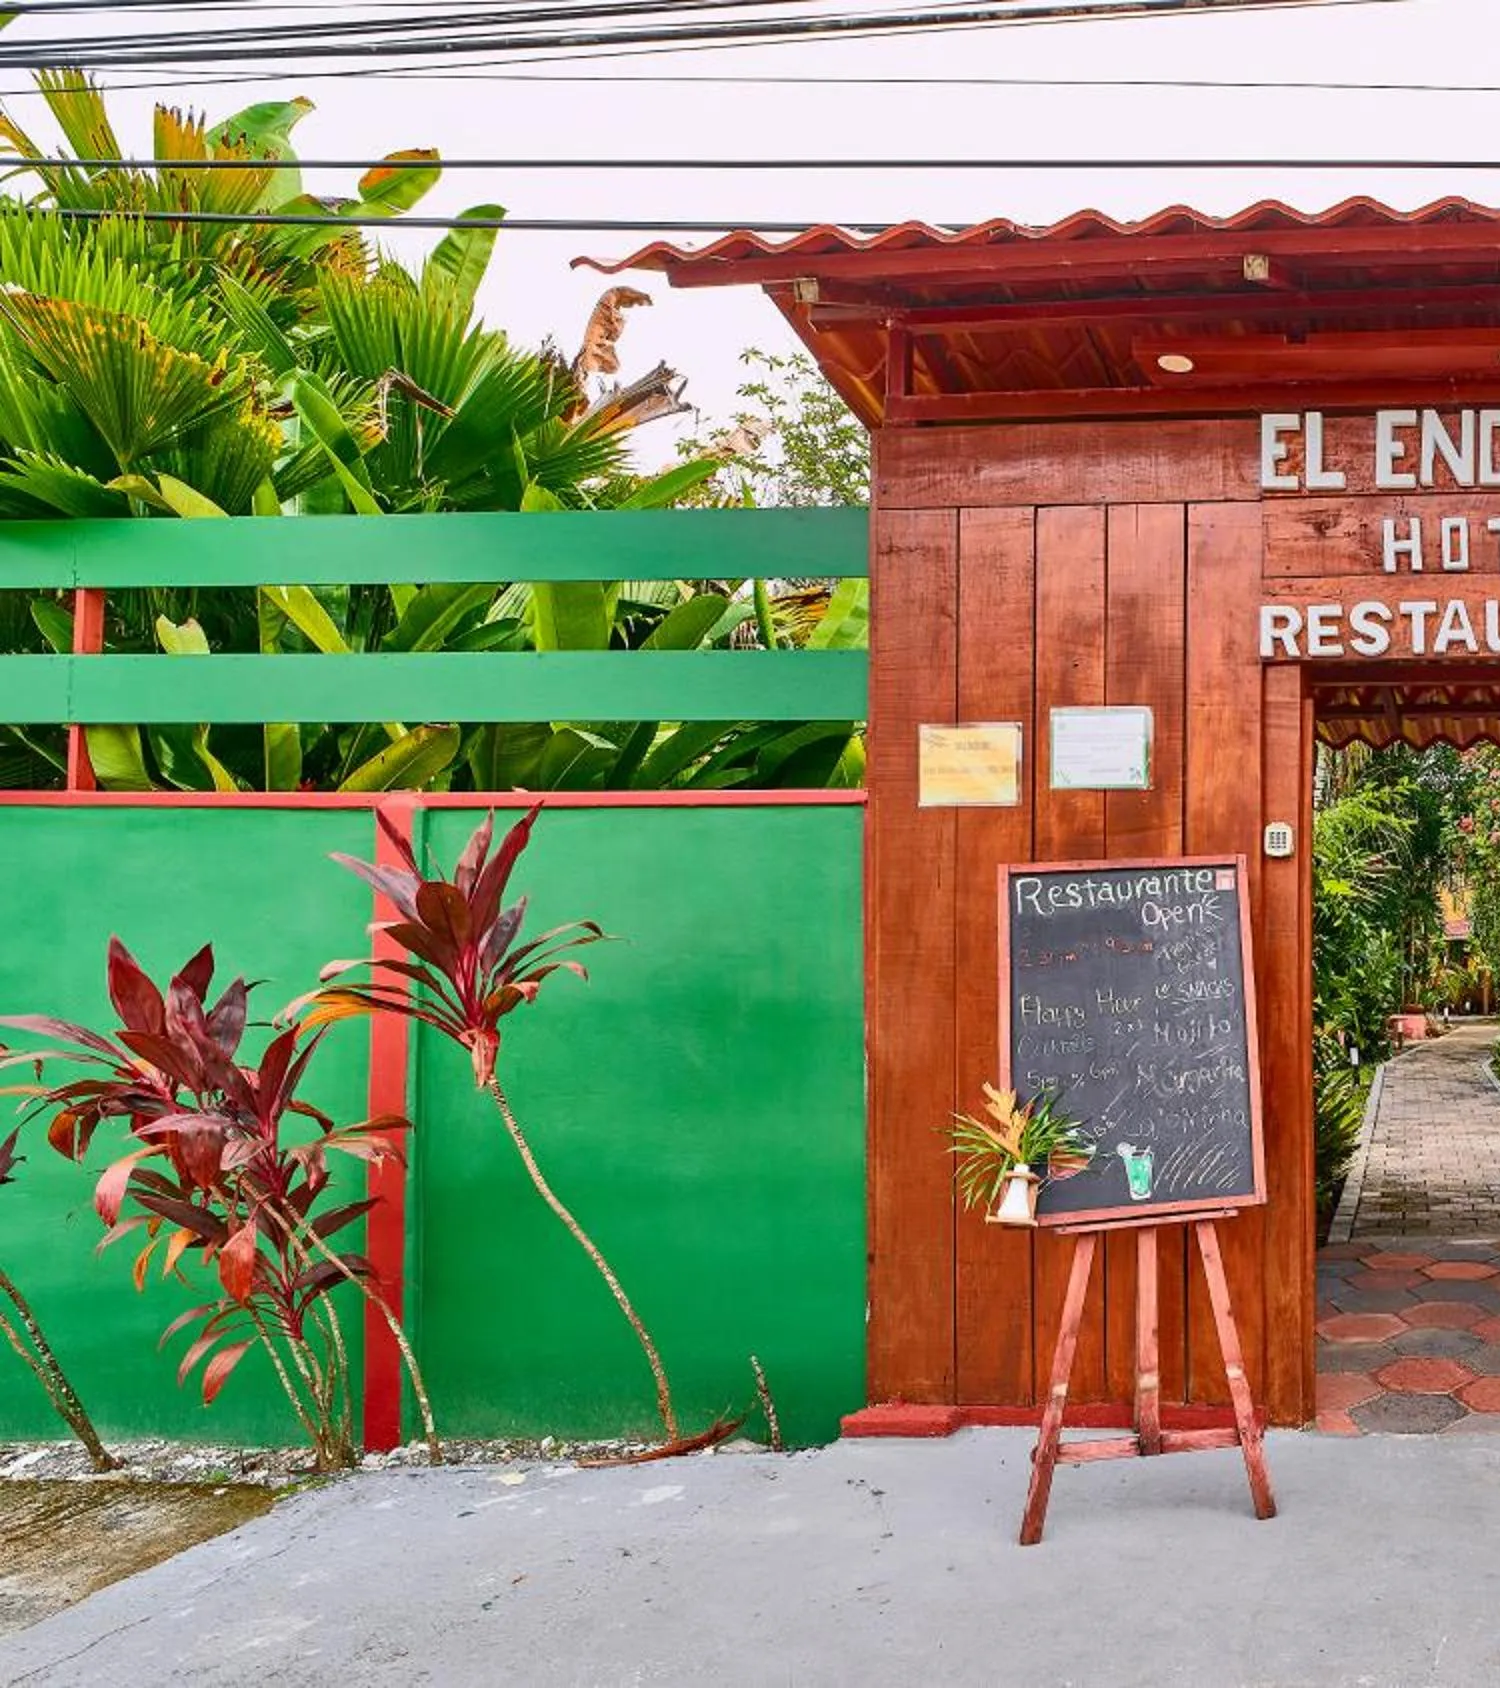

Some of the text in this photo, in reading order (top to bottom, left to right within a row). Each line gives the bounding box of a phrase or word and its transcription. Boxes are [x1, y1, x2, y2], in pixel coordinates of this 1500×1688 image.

[1261, 410, 1347, 491] EL
[1016, 869, 1212, 916] Restaurante
[1141, 900, 1203, 931] Open
